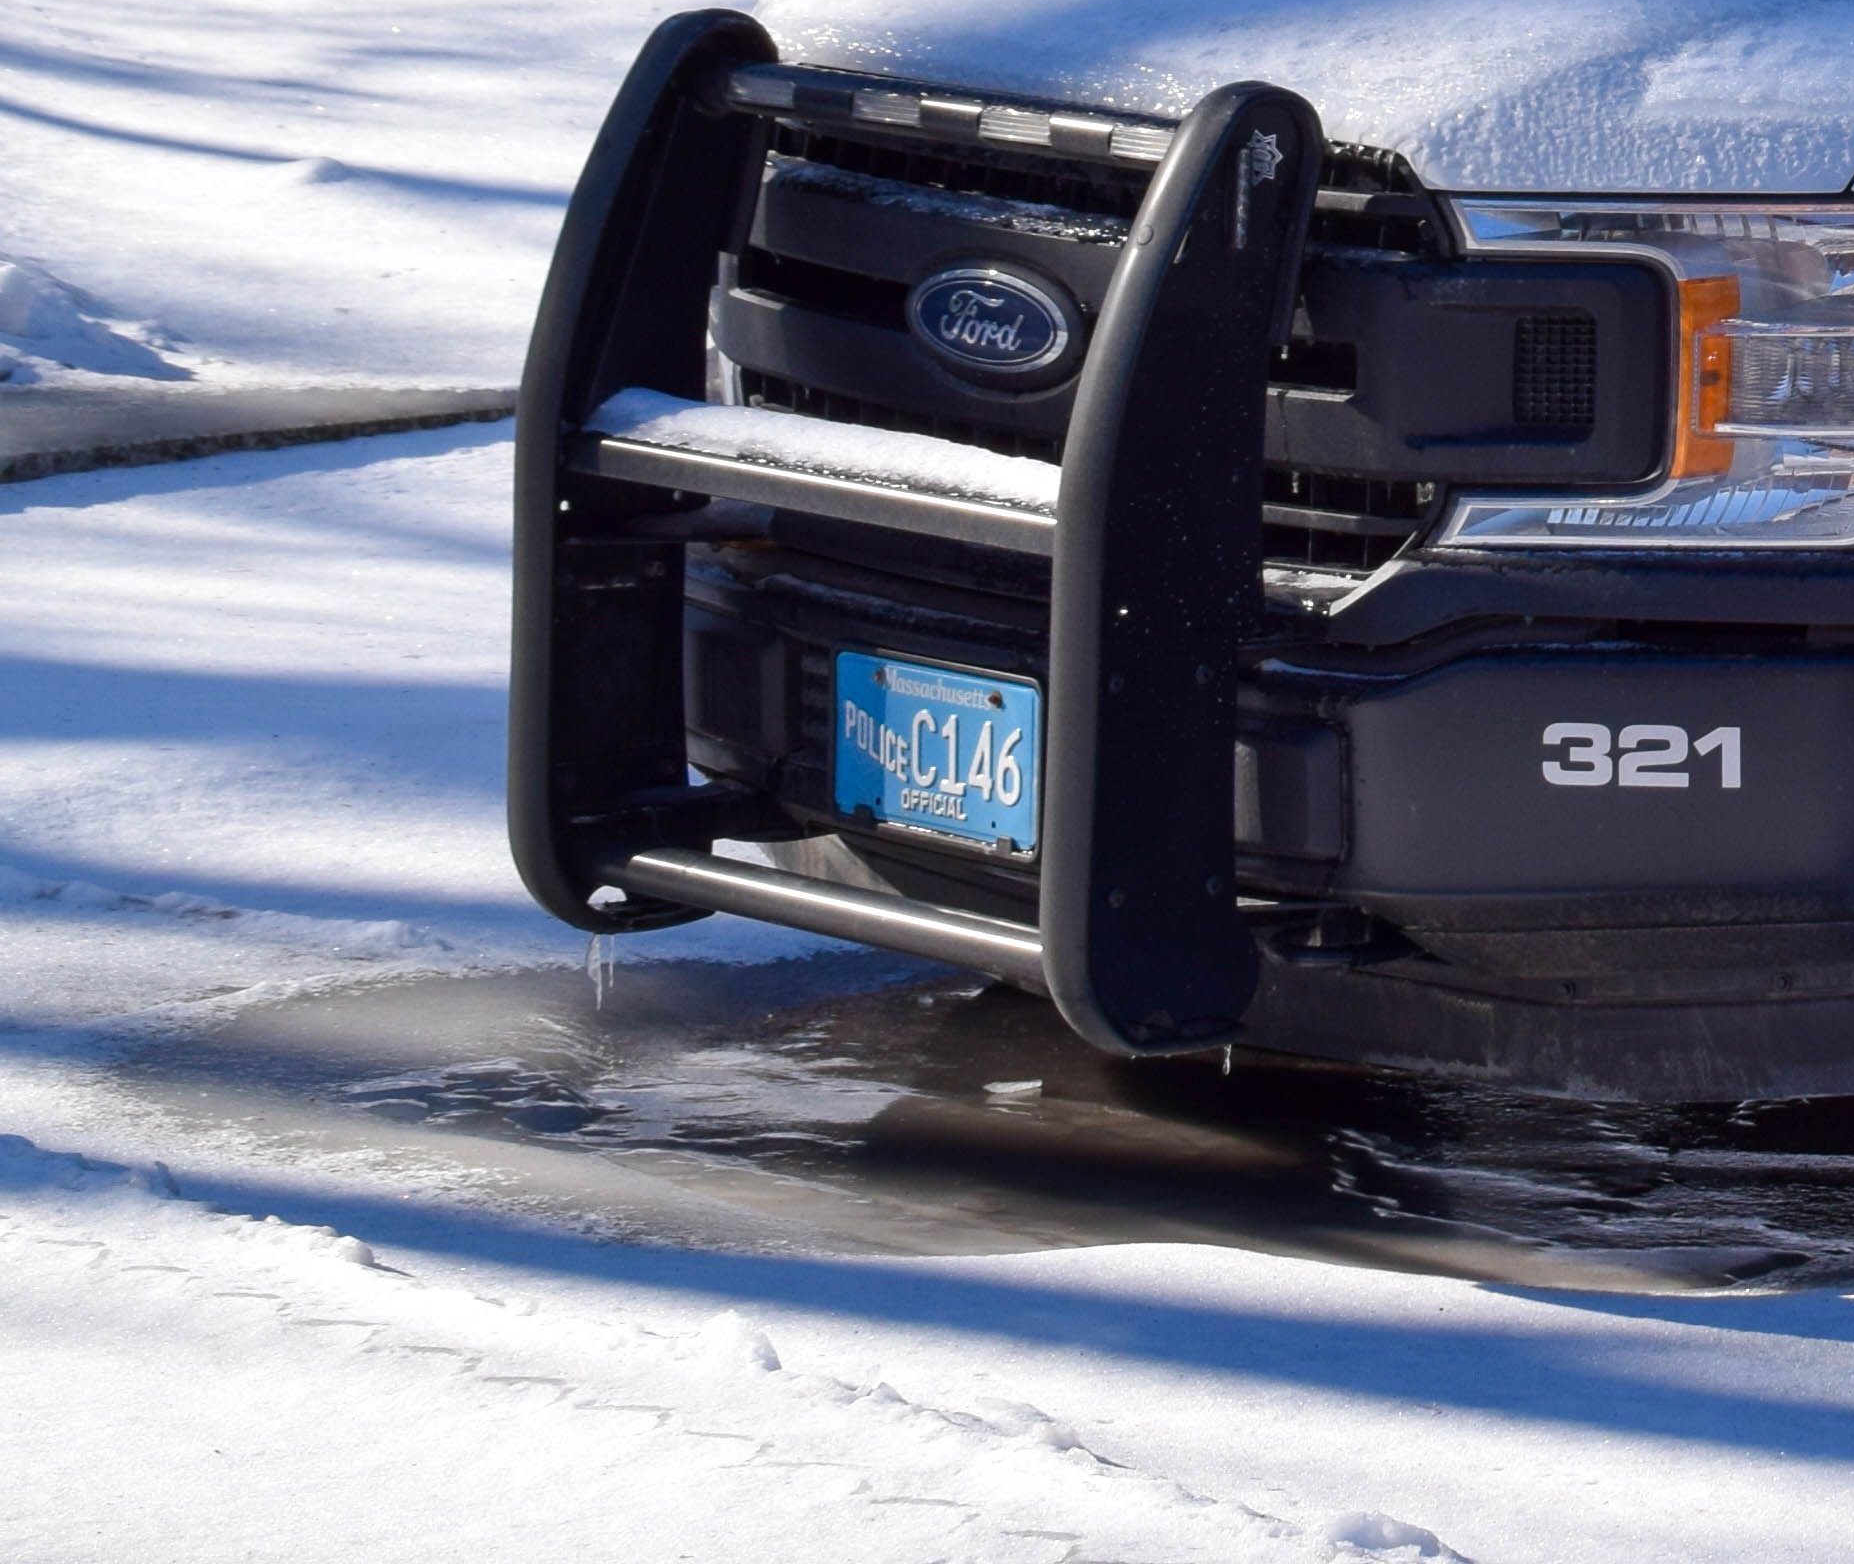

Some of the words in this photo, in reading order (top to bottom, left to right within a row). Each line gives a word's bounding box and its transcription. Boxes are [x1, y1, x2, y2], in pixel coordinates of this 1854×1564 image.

[940, 289, 1025, 351] Ford
[883, 666, 992, 709] Massachusetts
[844, 700, 909, 782] POLICE
[911, 708, 1023, 807] C146
[1542, 722, 1741, 788] 321
[901, 788, 968, 821] OFFICIAL
